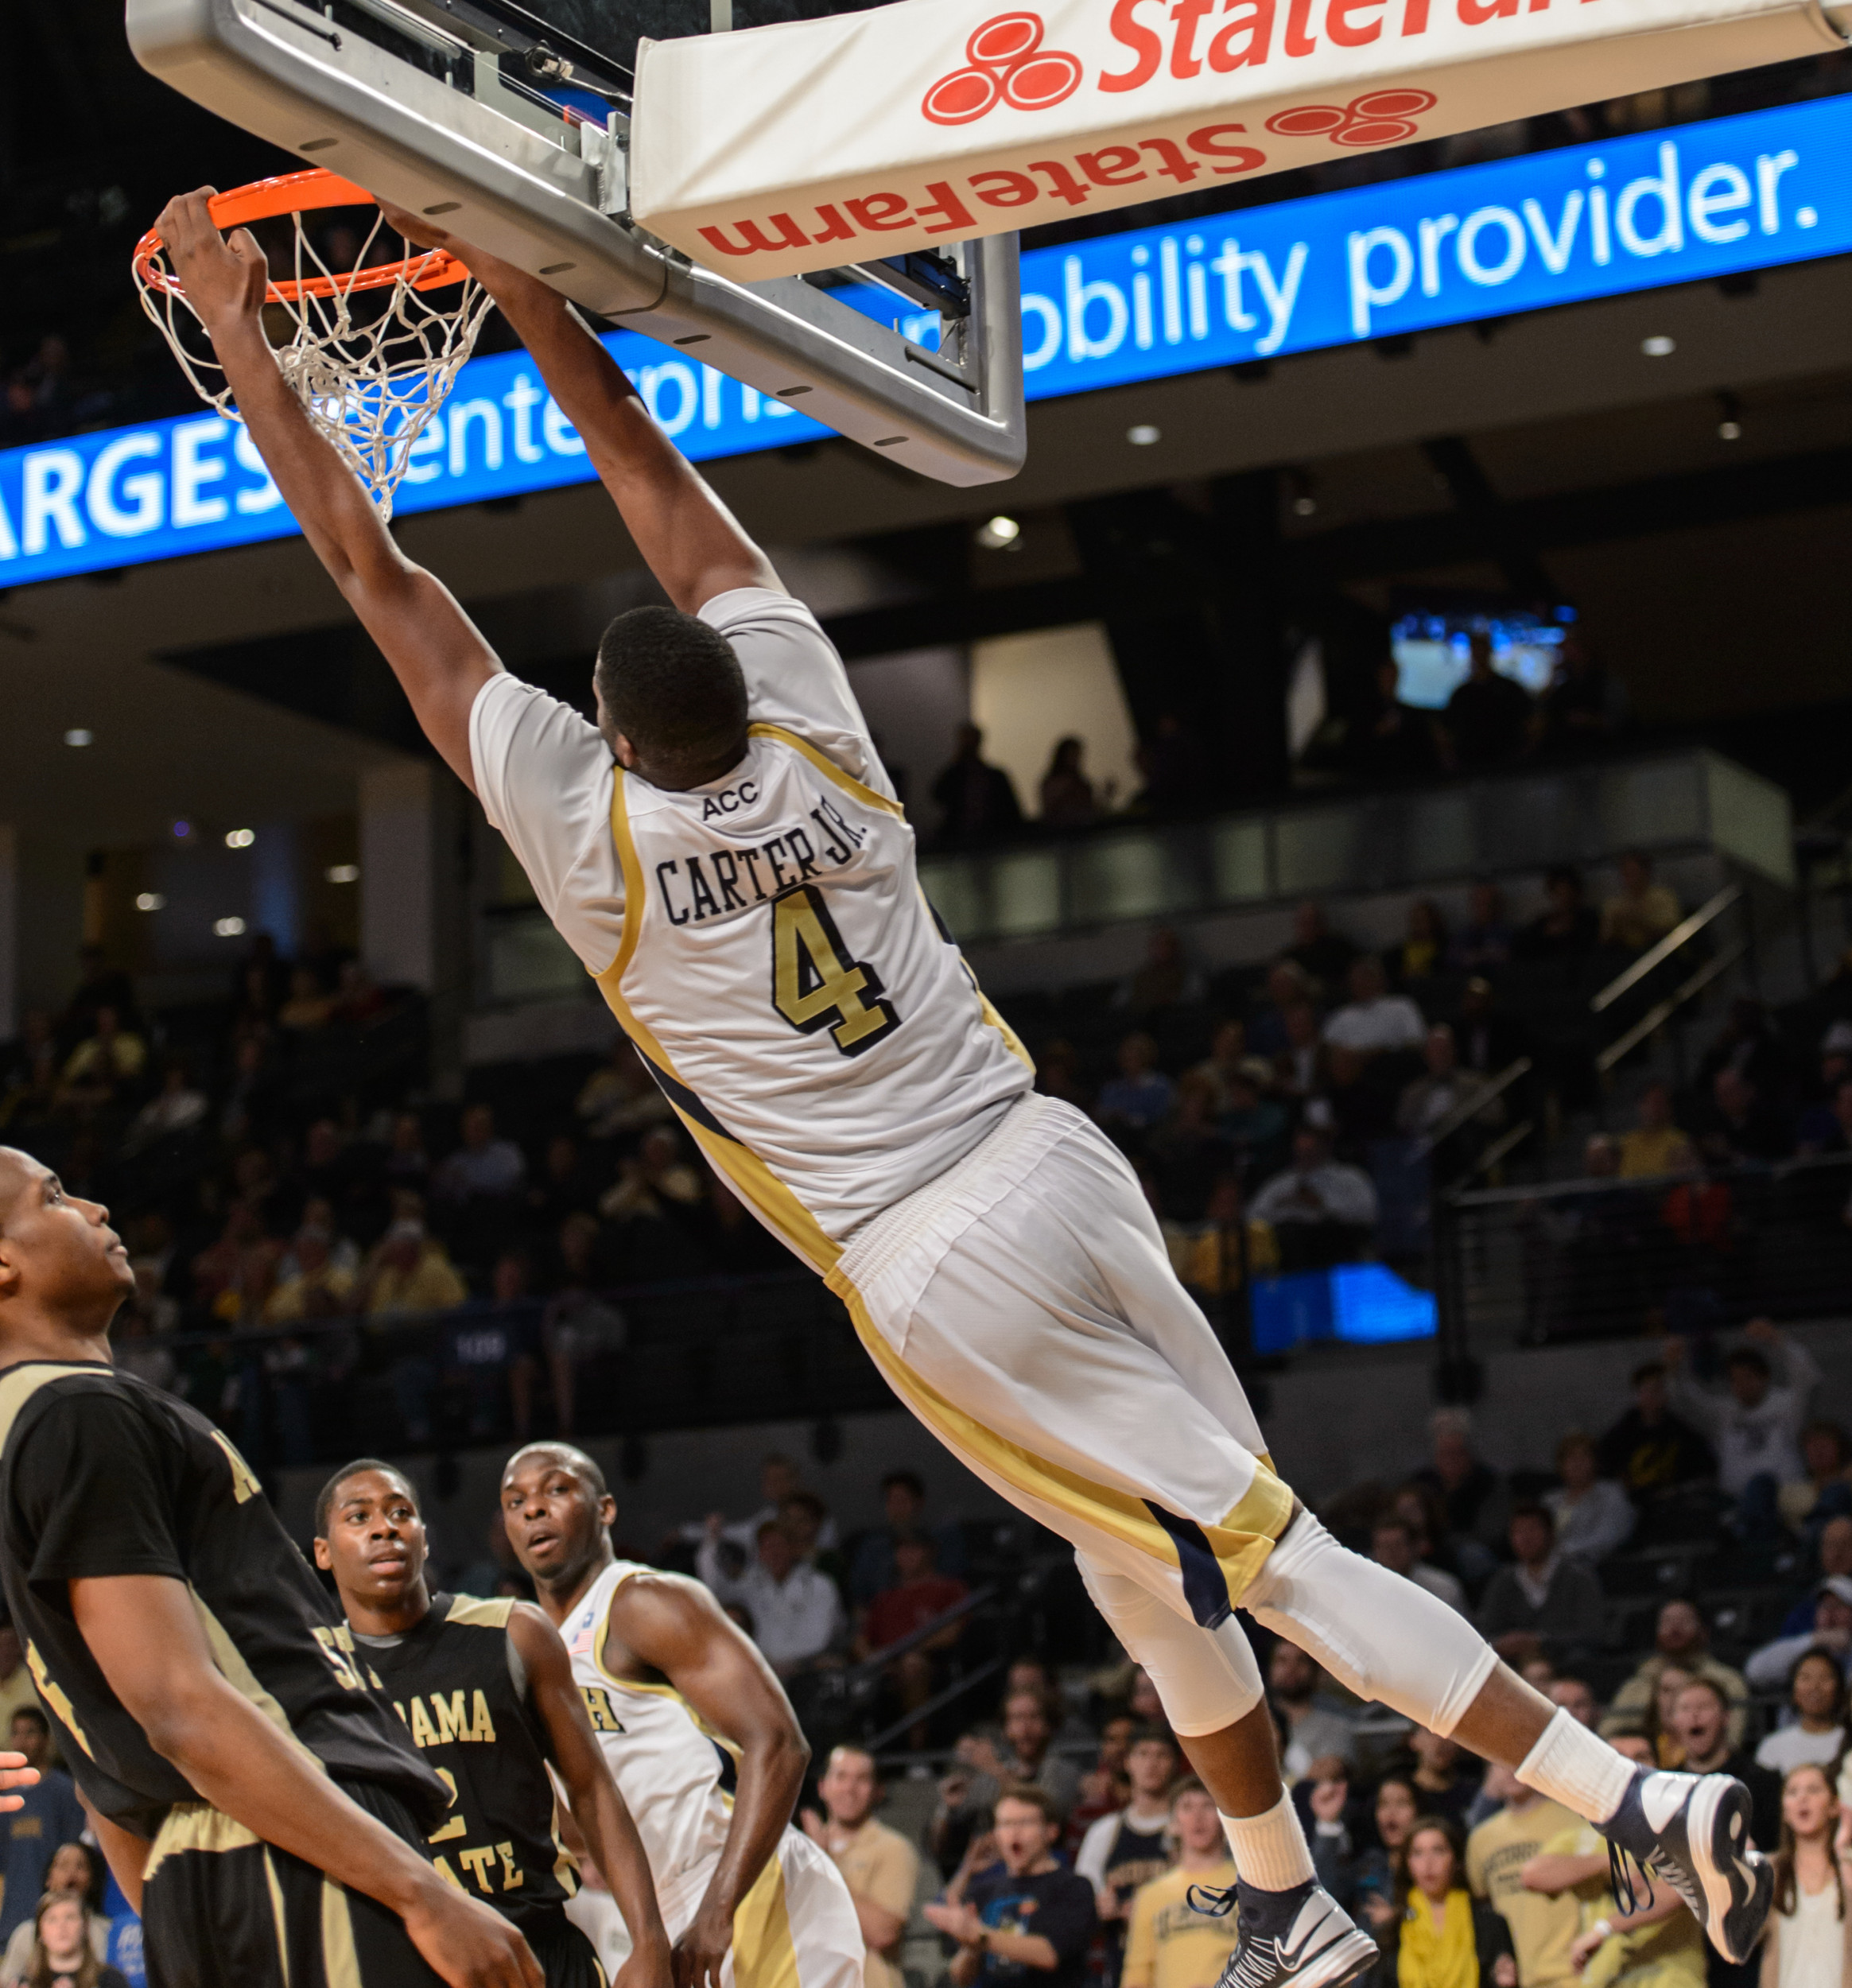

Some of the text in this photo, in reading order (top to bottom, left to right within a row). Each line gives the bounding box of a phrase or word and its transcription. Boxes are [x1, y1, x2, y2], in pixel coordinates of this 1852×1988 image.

[902, 234, 1310, 374] obility
[1346, 140, 1819, 338] provider.
[655, 794, 868, 926] CARTER JR.
[701, 781, 759, 821] ACC
[771, 883, 903, 1058] 4
